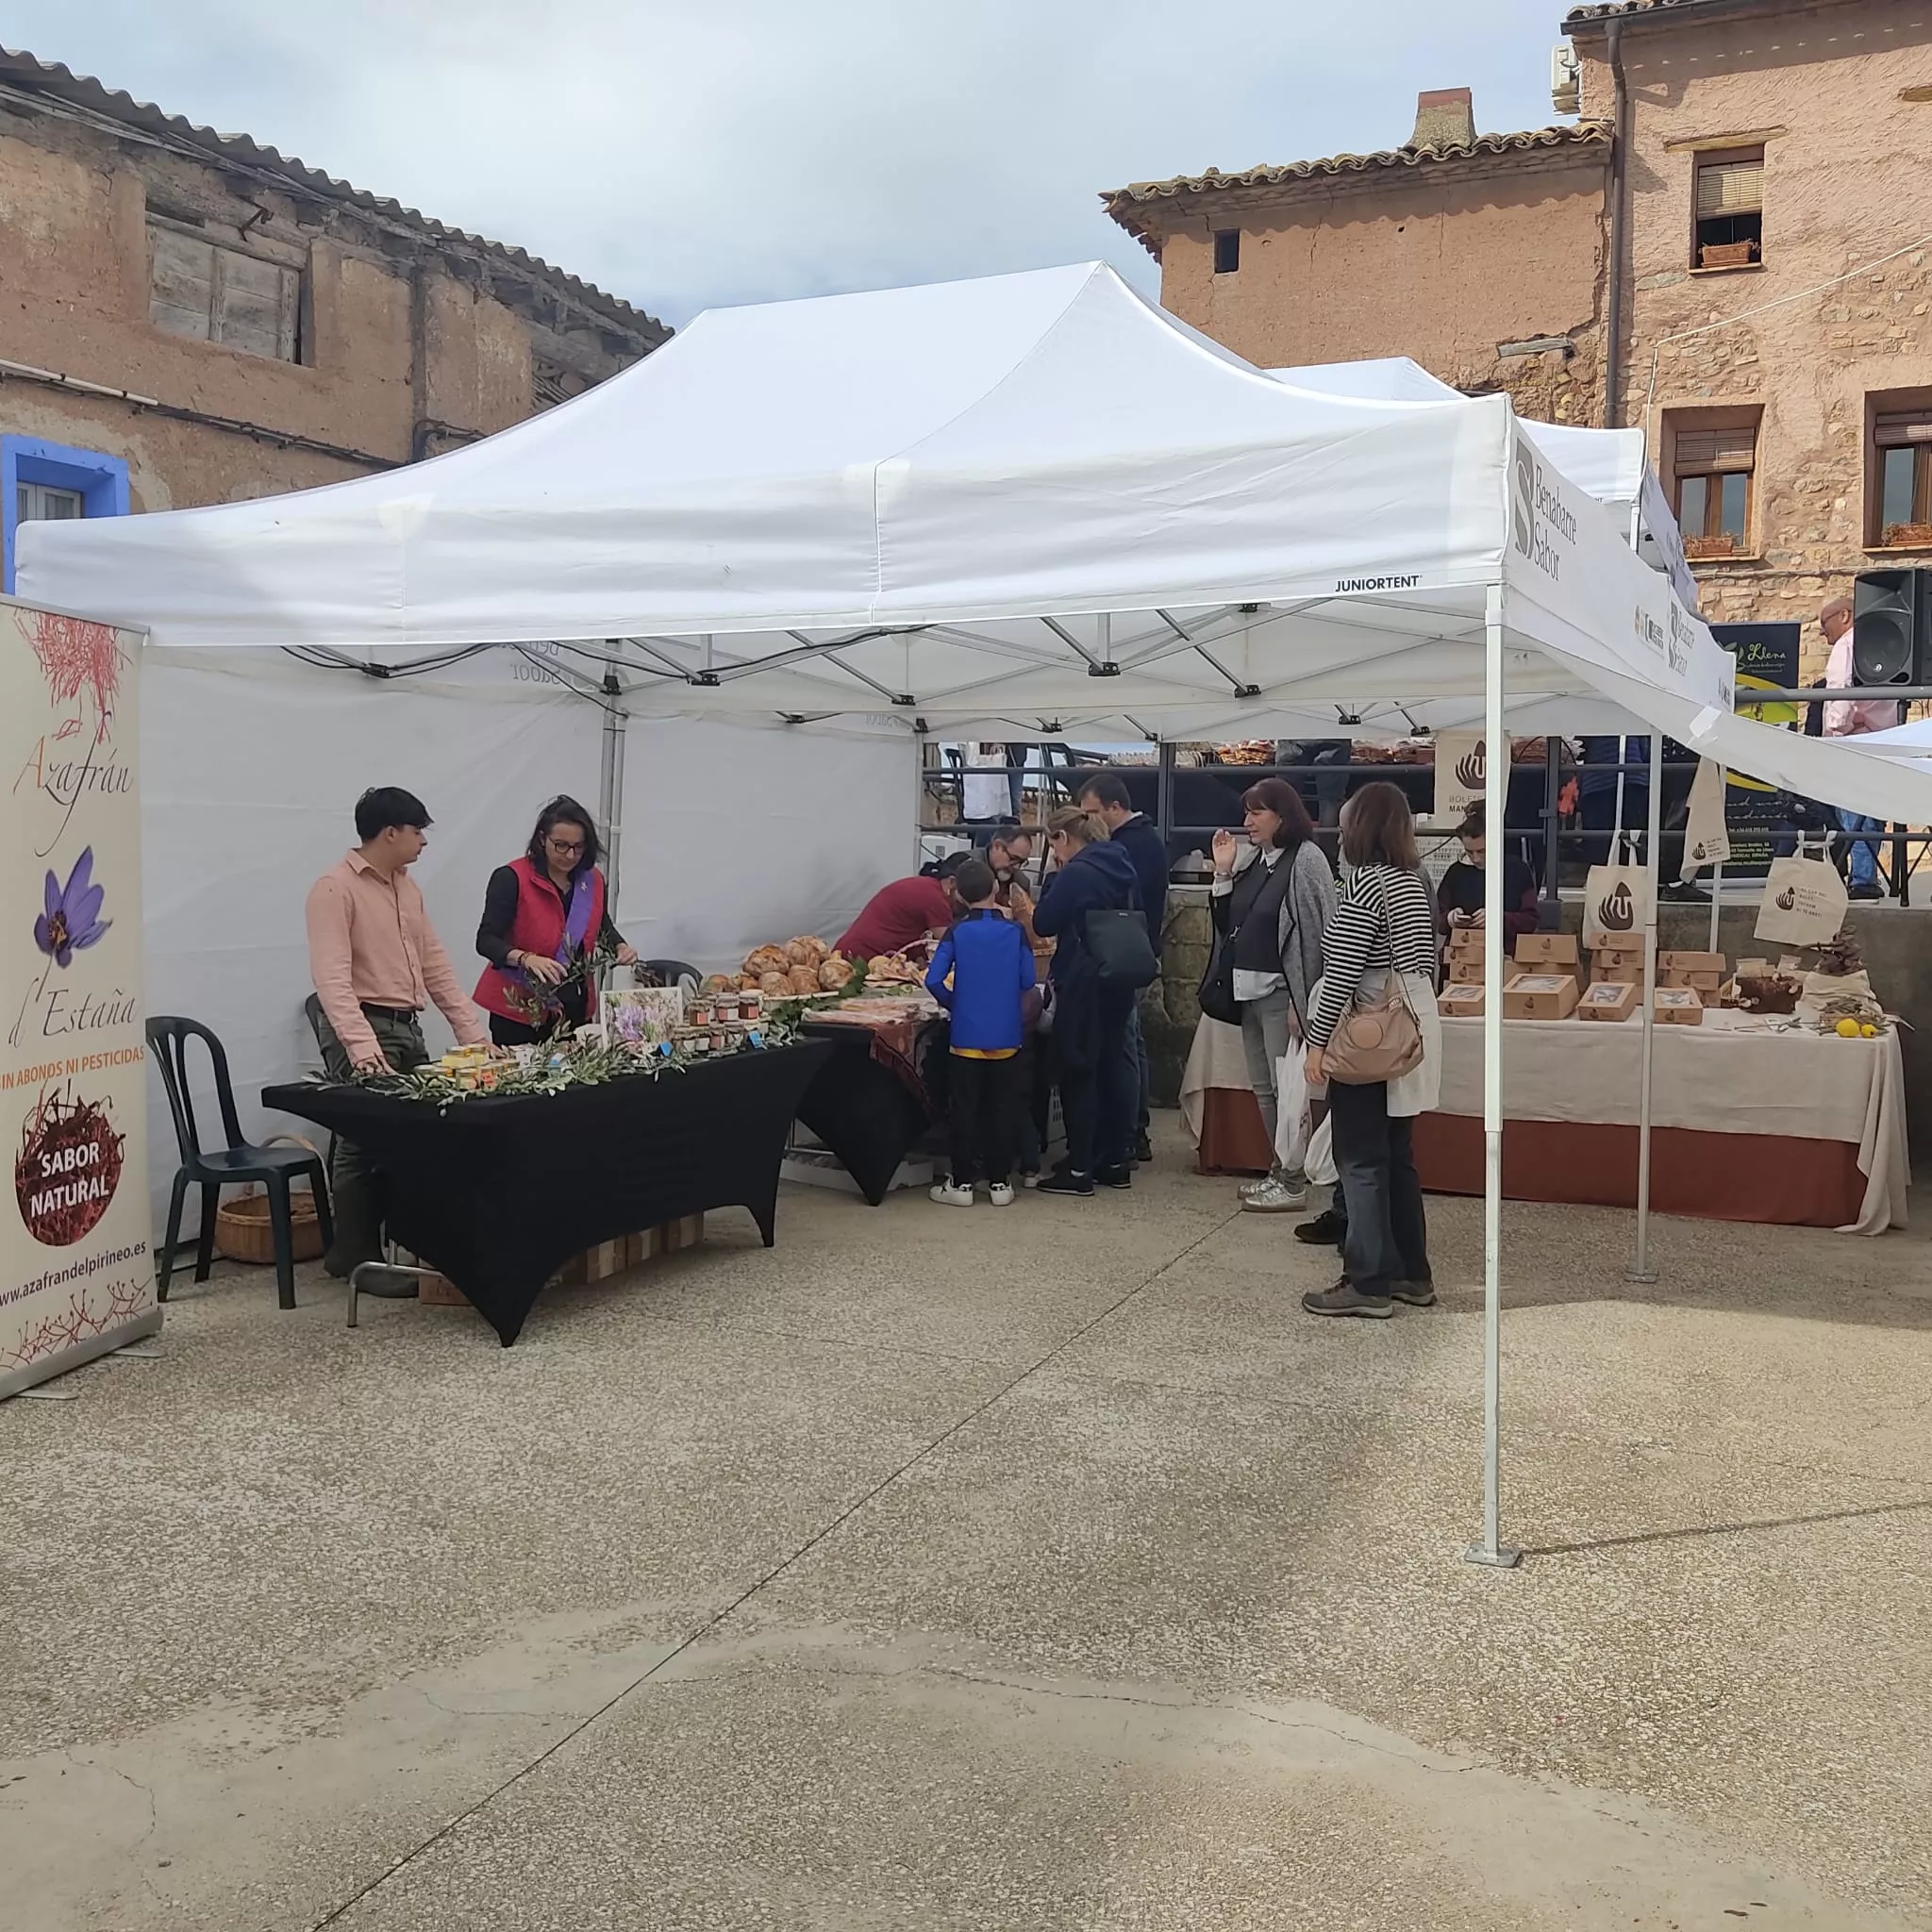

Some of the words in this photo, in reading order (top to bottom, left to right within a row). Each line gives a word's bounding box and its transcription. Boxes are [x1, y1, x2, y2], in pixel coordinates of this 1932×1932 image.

[1536, 463, 1577, 545] Benabarre
[1535, 521, 1559, 581] Sabor
[1335, 575, 1419, 592] JUNIORTENT
[1747, 642, 1787, 661] Llena
[13, 714, 134, 858] Azafrán
[0, 1073, 14, 1091] IN
[16, 1060, 63, 1087] ABONOS
[66, 1058, 79, 1075] NI
[82, 1045, 144, 1071] PESTICIDAS
[41, 1141, 100, 1177] SABOR
[29, 1174, 109, 1218] NATURAL
[0, 1241, 146, 1307] ww.azafrandelpirineo.es
